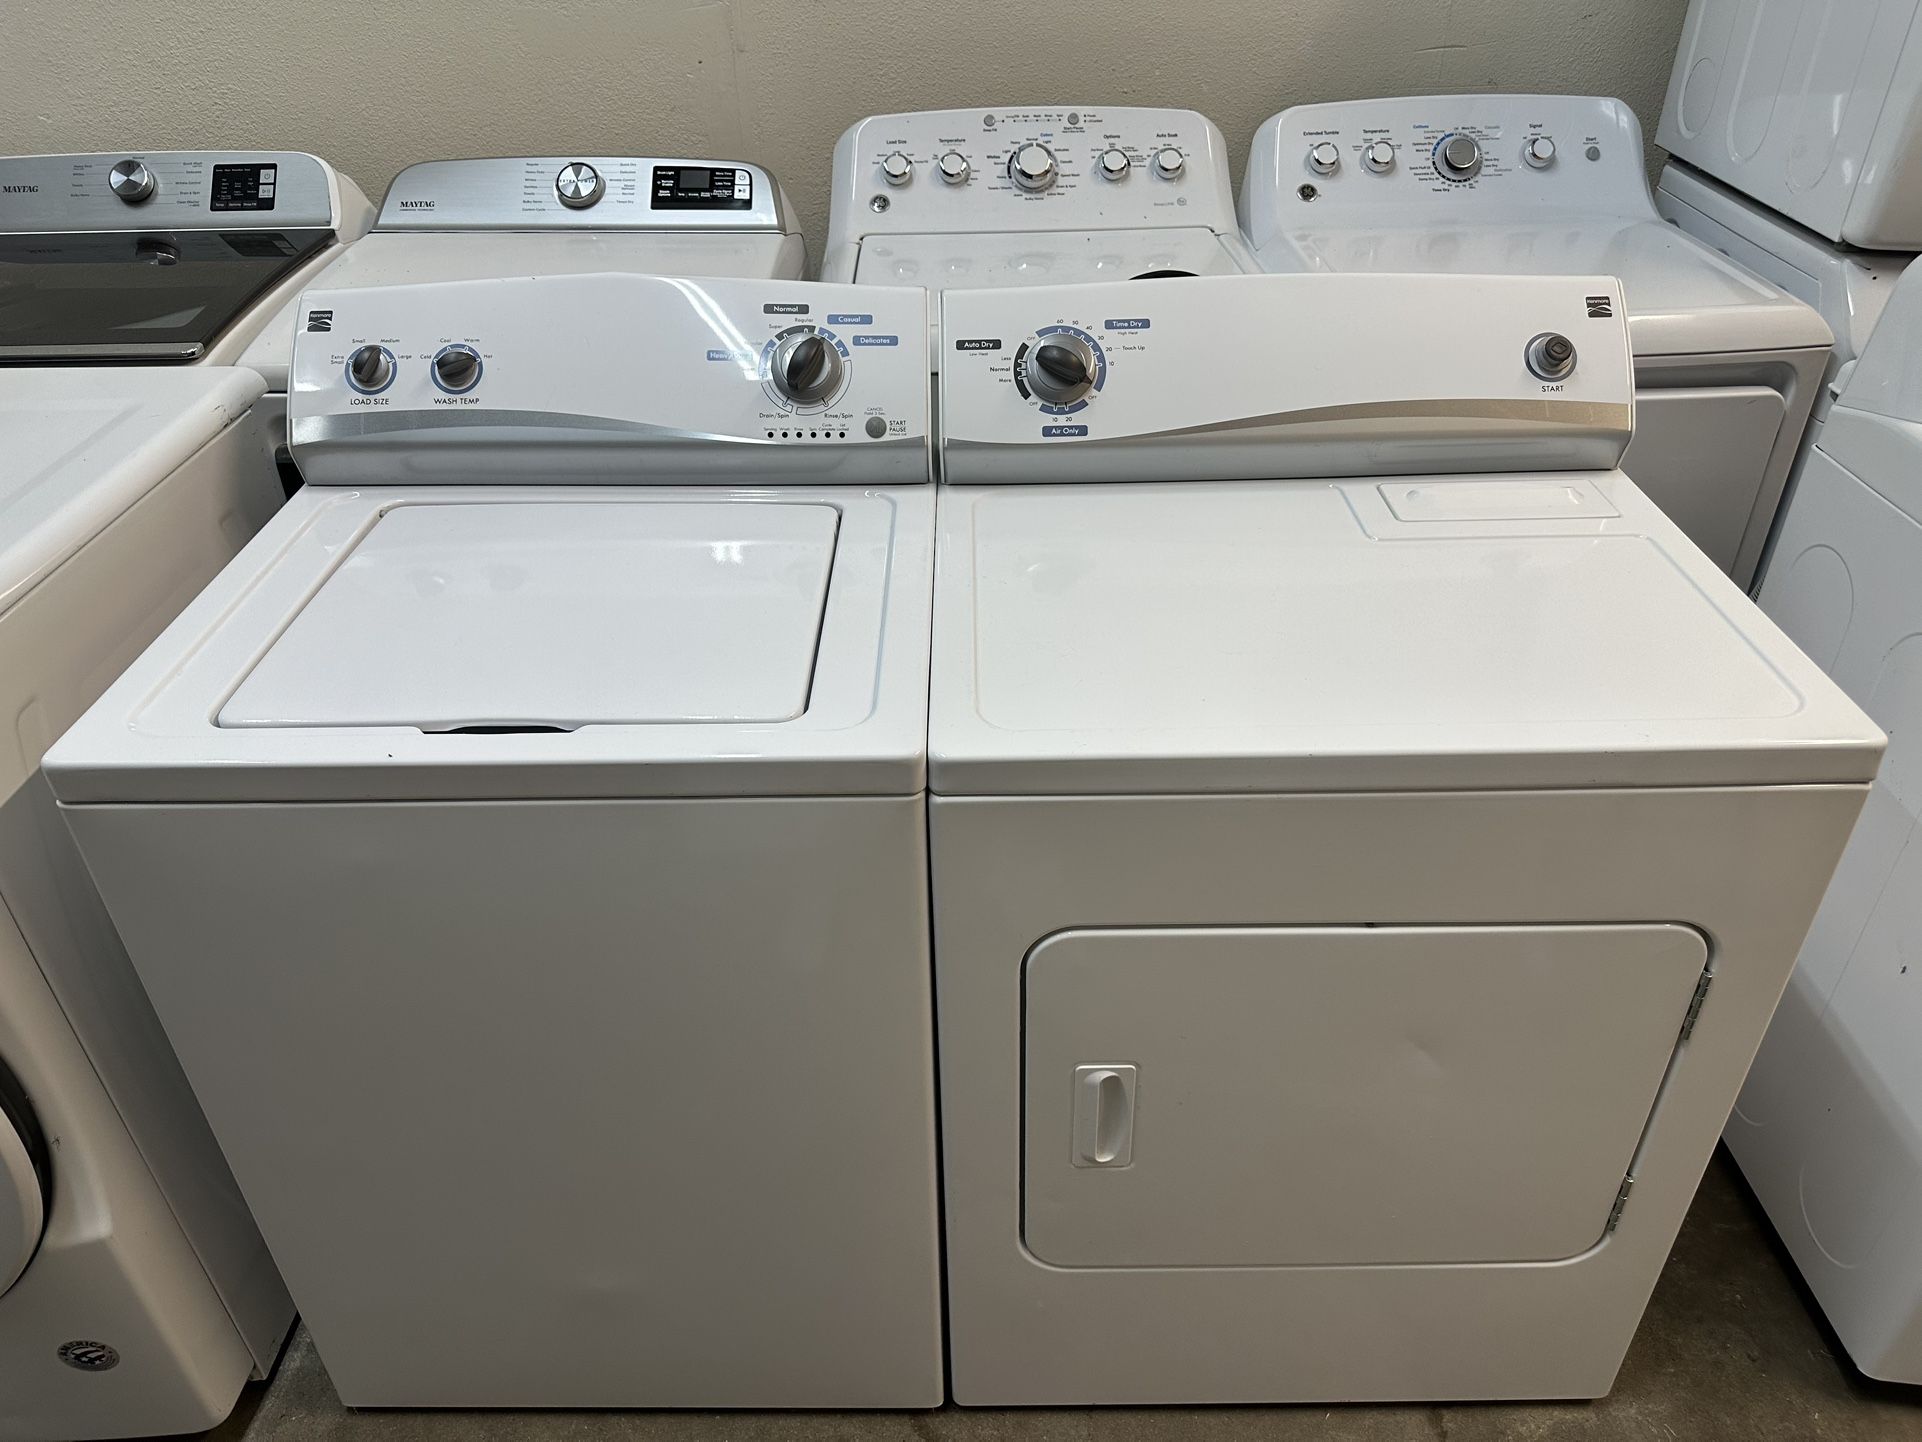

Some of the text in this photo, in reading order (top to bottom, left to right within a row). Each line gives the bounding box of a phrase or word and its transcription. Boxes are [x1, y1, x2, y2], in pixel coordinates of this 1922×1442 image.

[2, 185, 39, 193] MAYTAG
[400, 200, 435, 208] MAYTAG
[1063, 427, 1079, 435] Only
